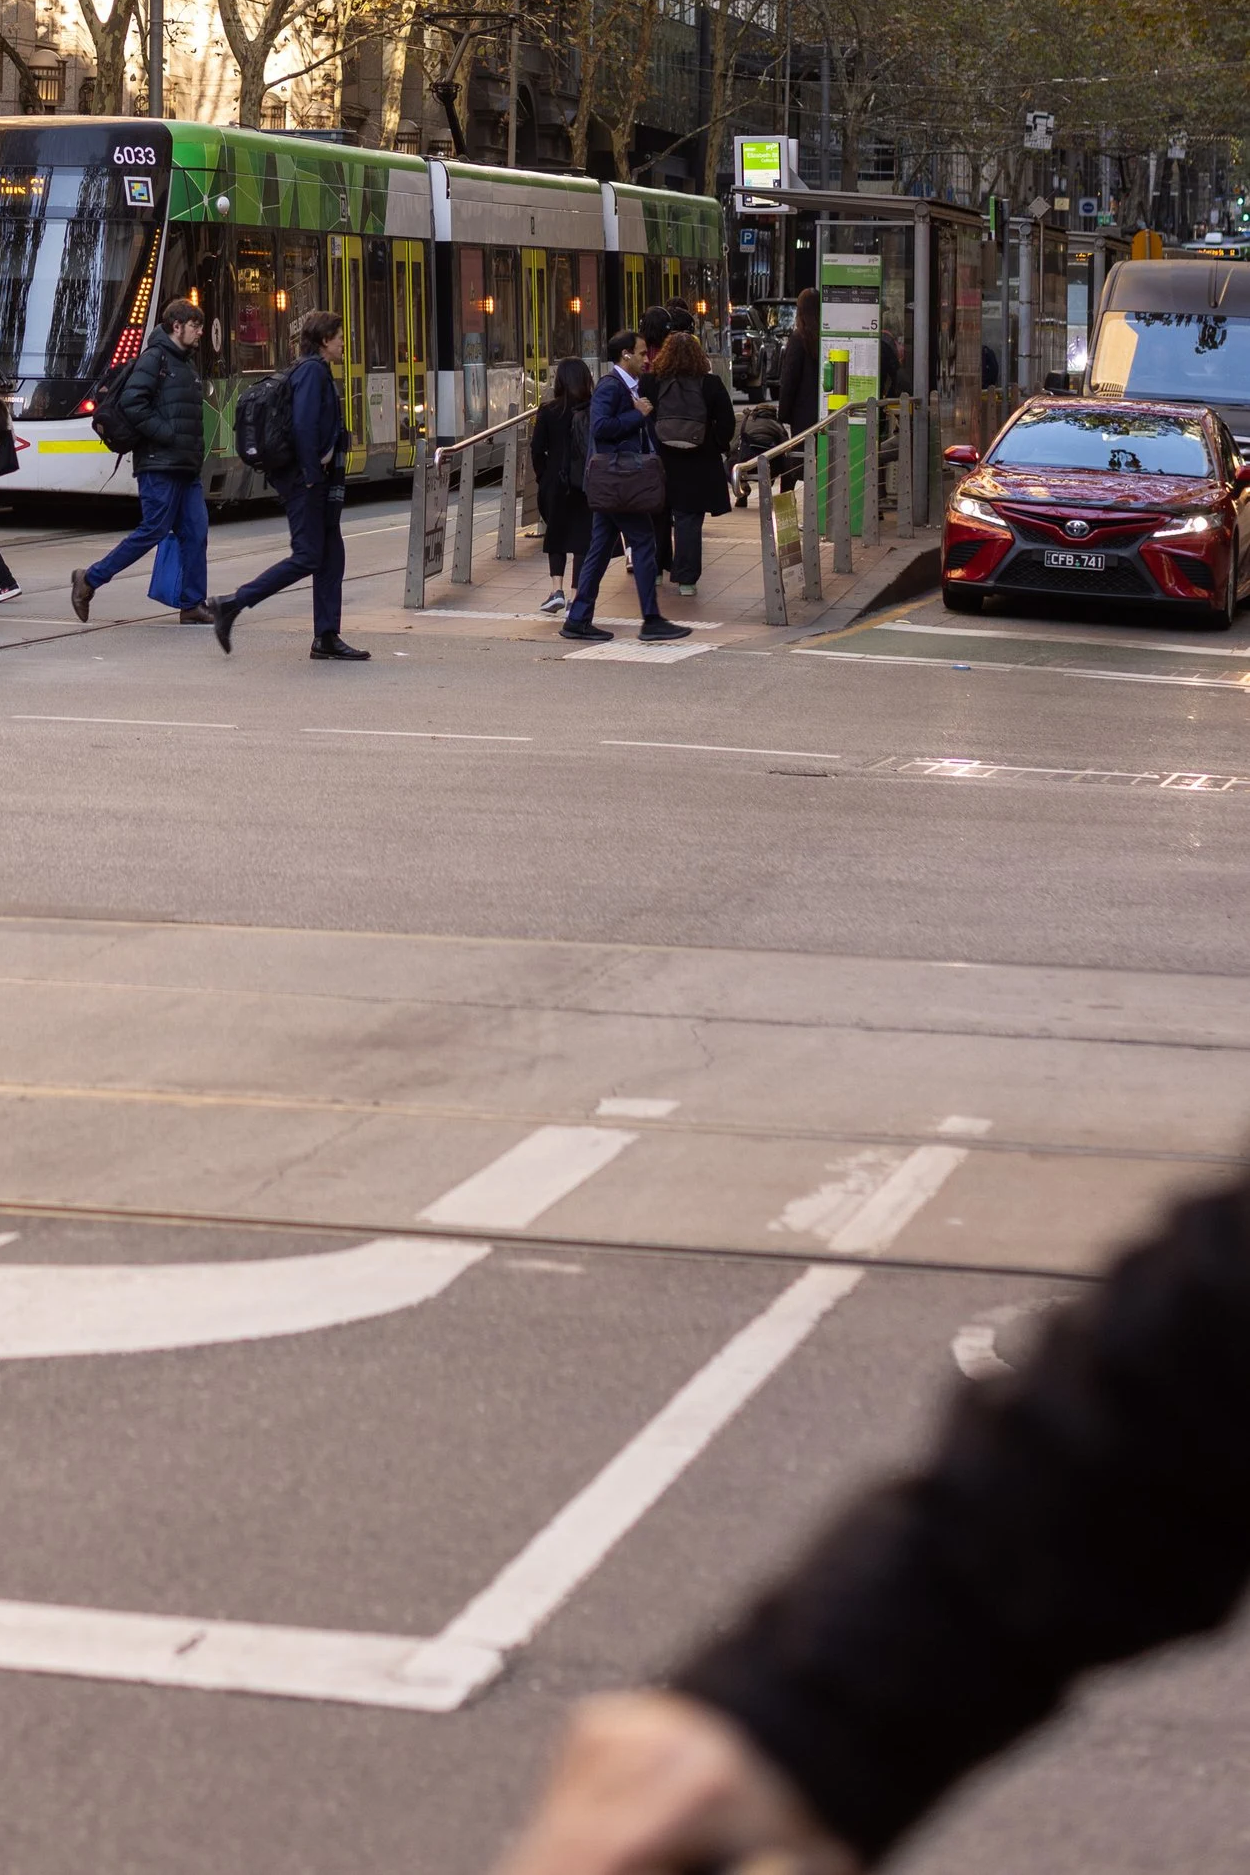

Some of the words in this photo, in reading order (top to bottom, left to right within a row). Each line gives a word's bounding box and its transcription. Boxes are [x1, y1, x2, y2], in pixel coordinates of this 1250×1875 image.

[113, 146, 156, 165] 6033
[744, 232, 752, 244] P
[871, 320, 878, 330] 5
[1051, 553, 1074, 566] CFB
[1080, 555, 1102, 568] 741
